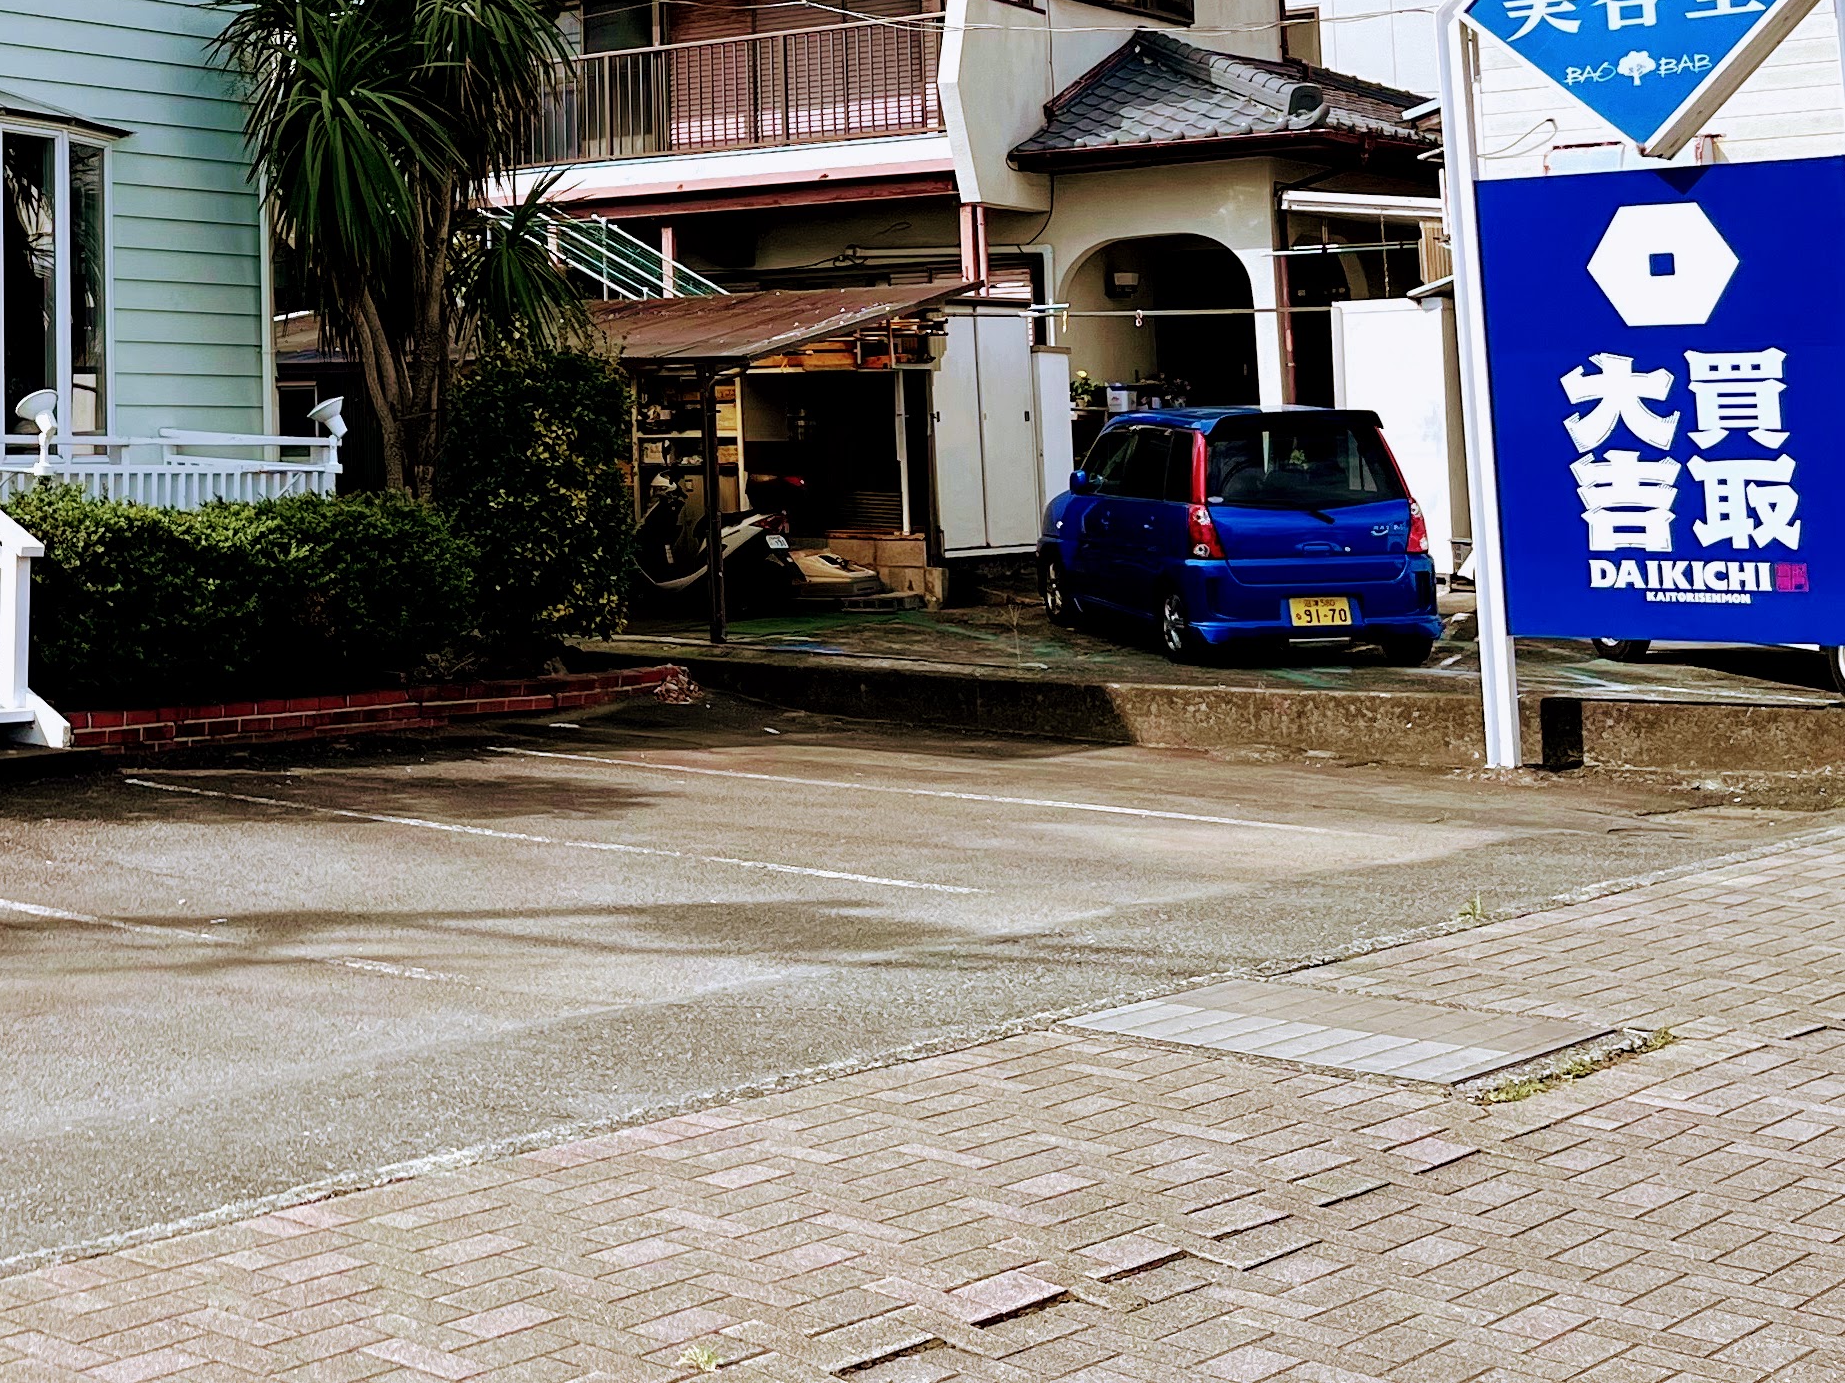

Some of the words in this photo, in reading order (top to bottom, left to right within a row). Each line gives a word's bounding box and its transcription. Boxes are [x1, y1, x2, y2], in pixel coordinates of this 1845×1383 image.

[1563, 61, 1616, 86] BAO
[1656, 53, 1712, 78] BAB
[1560, 352, 1682, 552] 大吉
[1683, 346, 1802, 551] 買取
[1588, 559, 1773, 592] DAIKICHI
[1645, 590, 1752, 604] KAITORISENMON
